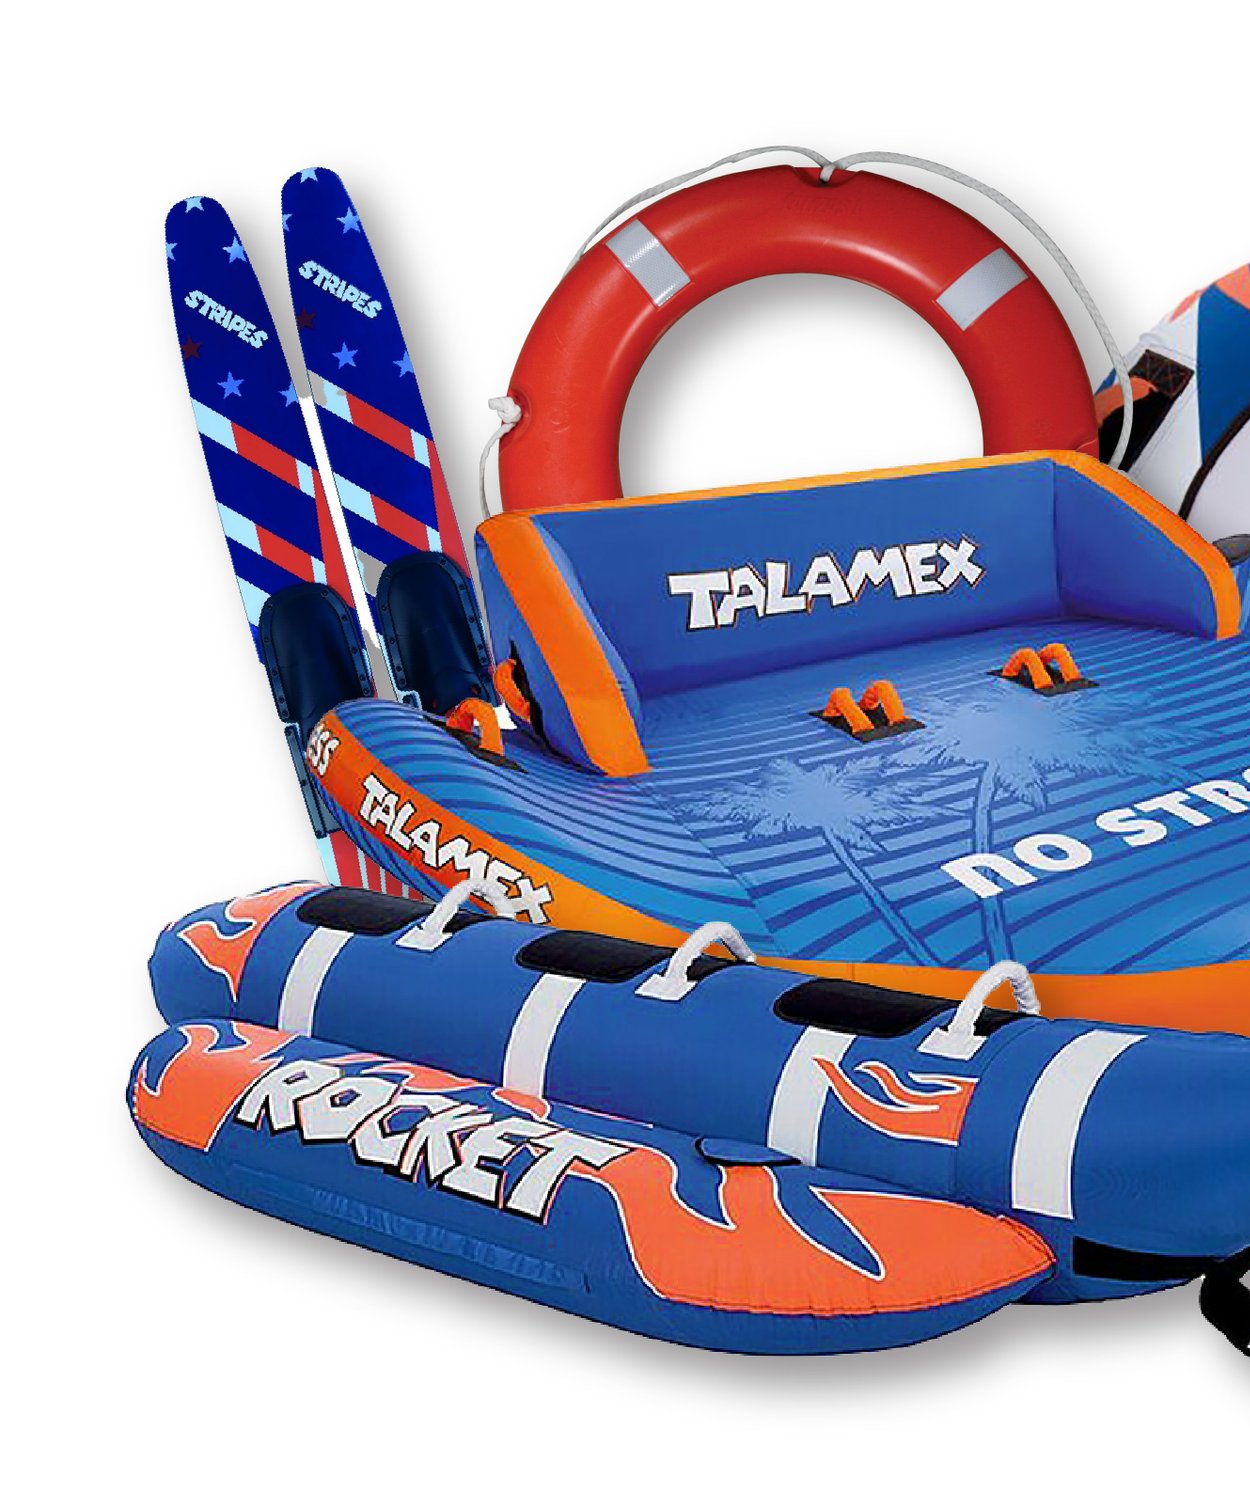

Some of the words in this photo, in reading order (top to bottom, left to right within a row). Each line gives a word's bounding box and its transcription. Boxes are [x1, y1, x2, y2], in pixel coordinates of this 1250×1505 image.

[184, 290, 268, 349] STRIPES
[298, 260, 383, 319] STRIPES
[666, 534, 986, 632] TALAMEX
[358, 772, 553, 924] TALAMEX
[234, 1060, 635, 1225] ROCKET
